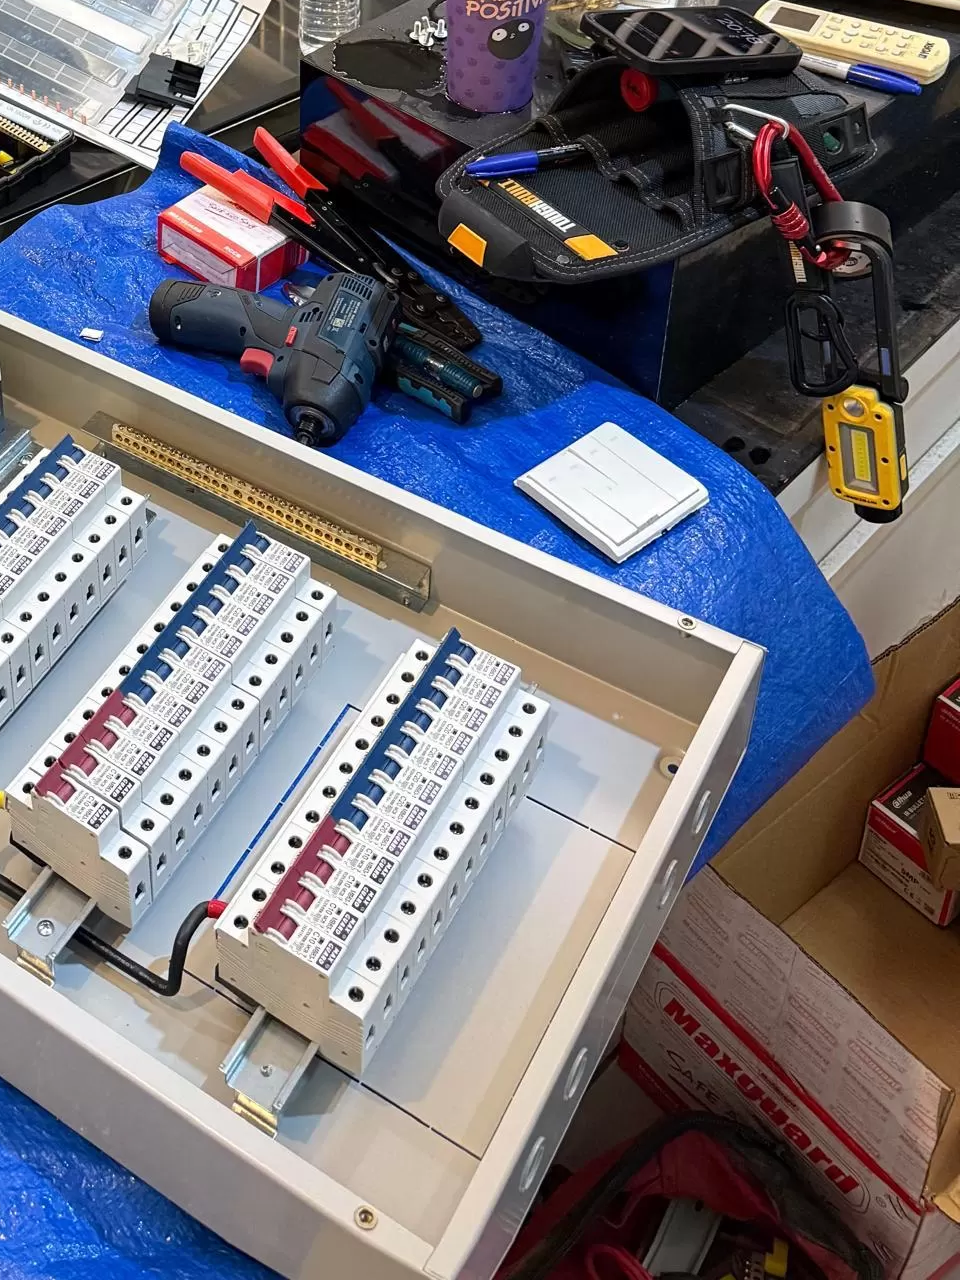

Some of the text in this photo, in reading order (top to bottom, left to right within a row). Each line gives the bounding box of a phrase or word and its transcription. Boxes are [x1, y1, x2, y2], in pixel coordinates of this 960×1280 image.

[498, 178, 577, 233] TOUGHBUILT
[150, 729, 167, 747] GUARD
[159, 732, 171, 745] MAX
[131, 752, 149, 771] GUARD
[140, 756, 154, 769] MAX
[110, 778, 129, 798] GUARD
[119, 781, 133, 796] MAX
[88, 804, 106, 825] GUARD
[97, 808, 111, 822] MAX
[360, 847, 373, 861] C10
[370, 858, 387, 880] GUARD
[379, 862, 392, 877] MAX
[343, 874, 355, 888] C10
[352, 885, 370, 908] GUARD
[362, 890, 375, 905] MAX
[325, 902, 338, 916] C10
[334, 913, 351, 936] GUARD
[343, 917, 356, 933] MAX
[307, 930, 320, 945] C10
[316, 942, 335, 965] GUARD
[326, 946, 340, 962] MAX
[666, 1049, 721, 1105] SAFE
[663, 997, 859, 1194] Maxguard
